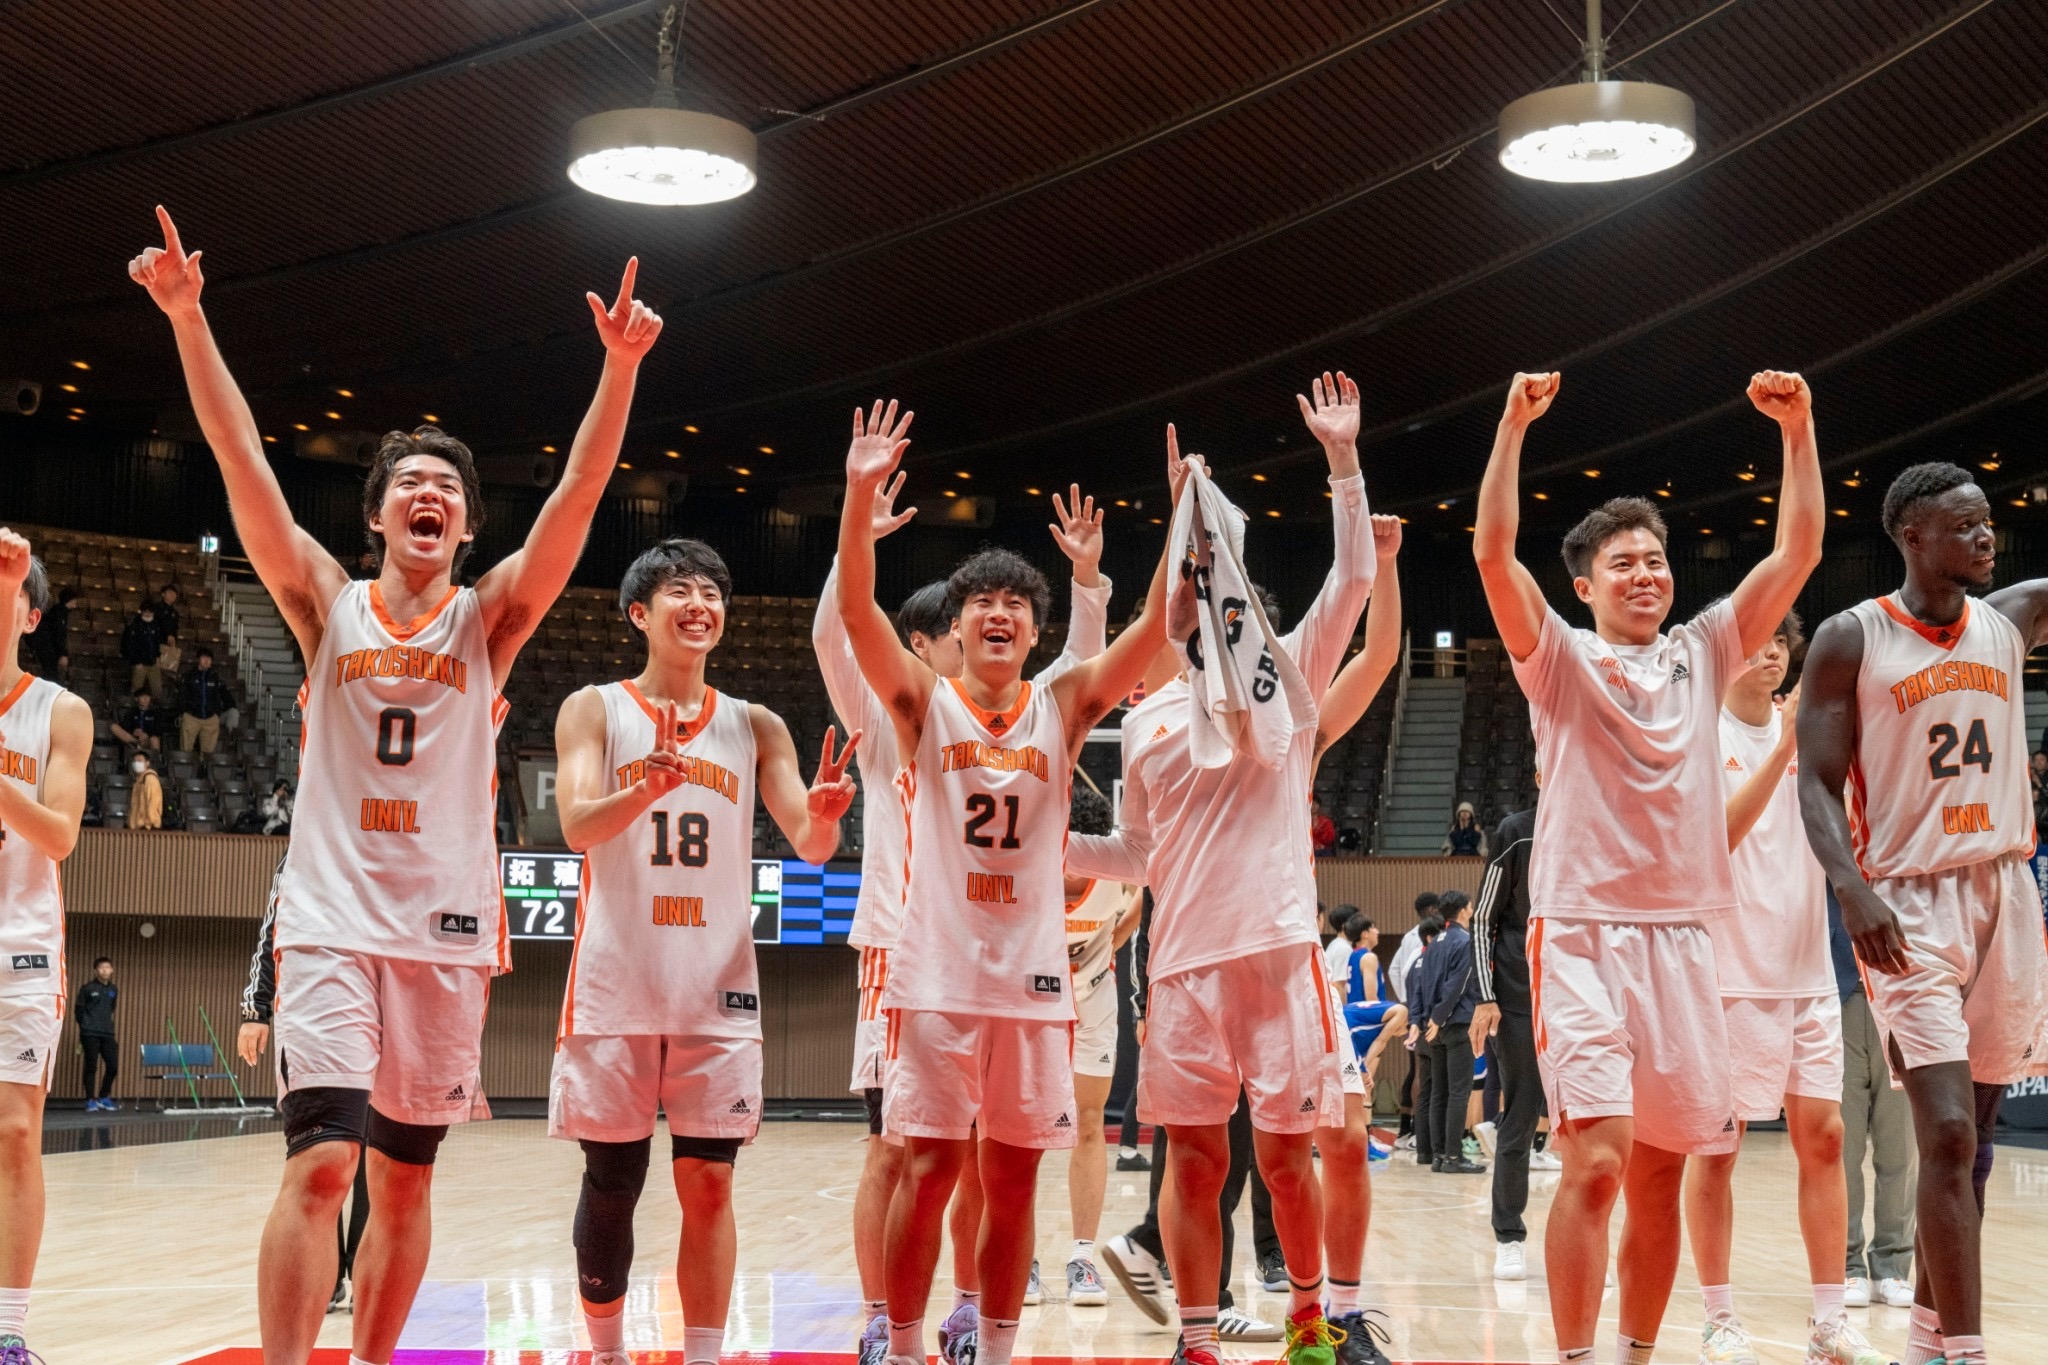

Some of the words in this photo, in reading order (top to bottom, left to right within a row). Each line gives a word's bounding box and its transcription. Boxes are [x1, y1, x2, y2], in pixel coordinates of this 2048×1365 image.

[336, 644, 467, 694] TAKUSHOKU
[1252, 642, 1279, 703] GA
[1890, 661, 2008, 714] TAKUSHOKU
[376, 707, 417, 766] 0
[941, 740, 1049, 783] TAKUSHOKU
[1928, 718, 1993, 780] 24
[616, 753, 739, 805] TAHOKU
[360, 798, 420, 833] UNIV.
[650, 811, 709, 868] 18
[964, 793, 1020, 849] 21
[1943, 803, 1995, 835] UNIV.
[652, 895, 707, 927] UNIV.
[966, 872, 1018, 904] UNIV.
[521, 900, 566, 934] 72
